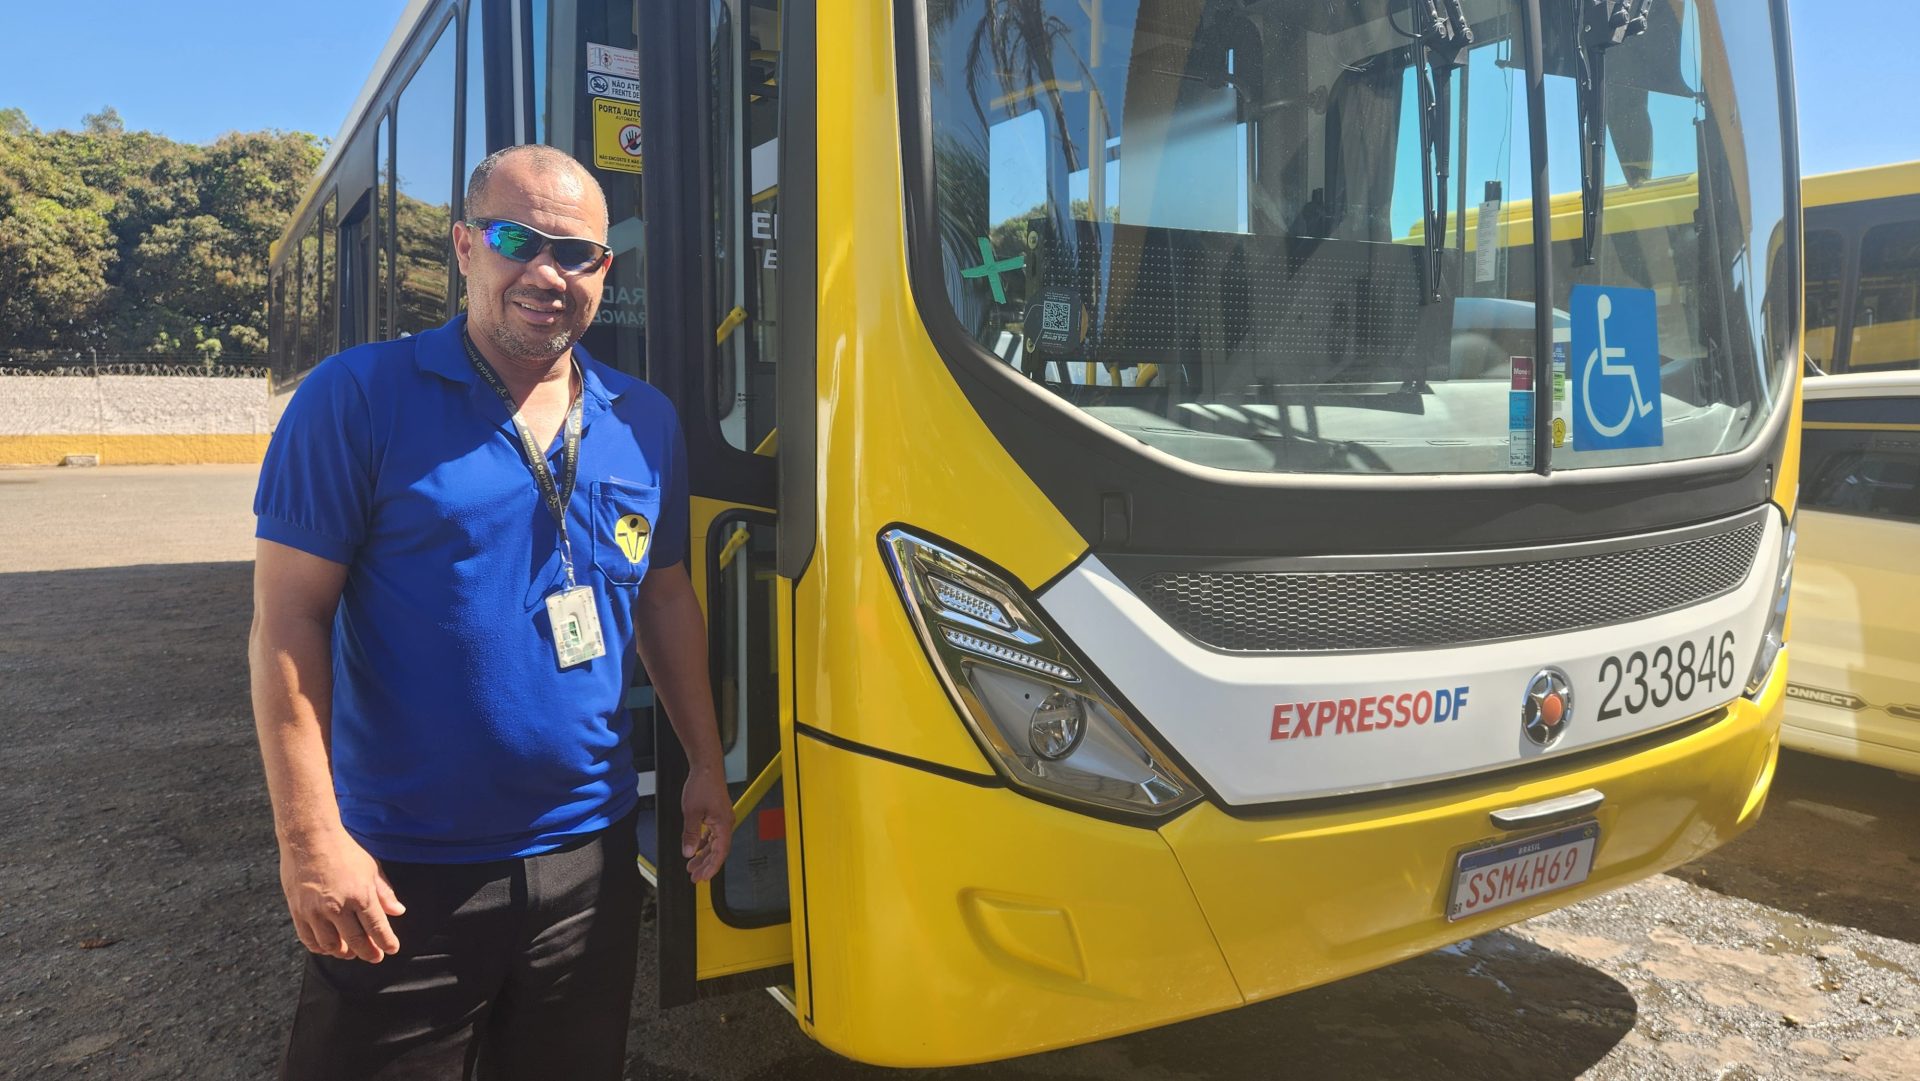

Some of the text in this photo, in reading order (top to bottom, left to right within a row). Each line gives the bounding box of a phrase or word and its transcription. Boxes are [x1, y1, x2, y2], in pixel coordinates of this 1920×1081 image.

[611, 87, 632, 98] FRENTE
[598, 104, 622, 116] PORTA
[751, 211, 778, 240] E
[1597, 630, 1735, 722] 233846
[1518, 842, 1541, 856] BRASIL
[1466, 847, 1578, 909] SSM4H69
